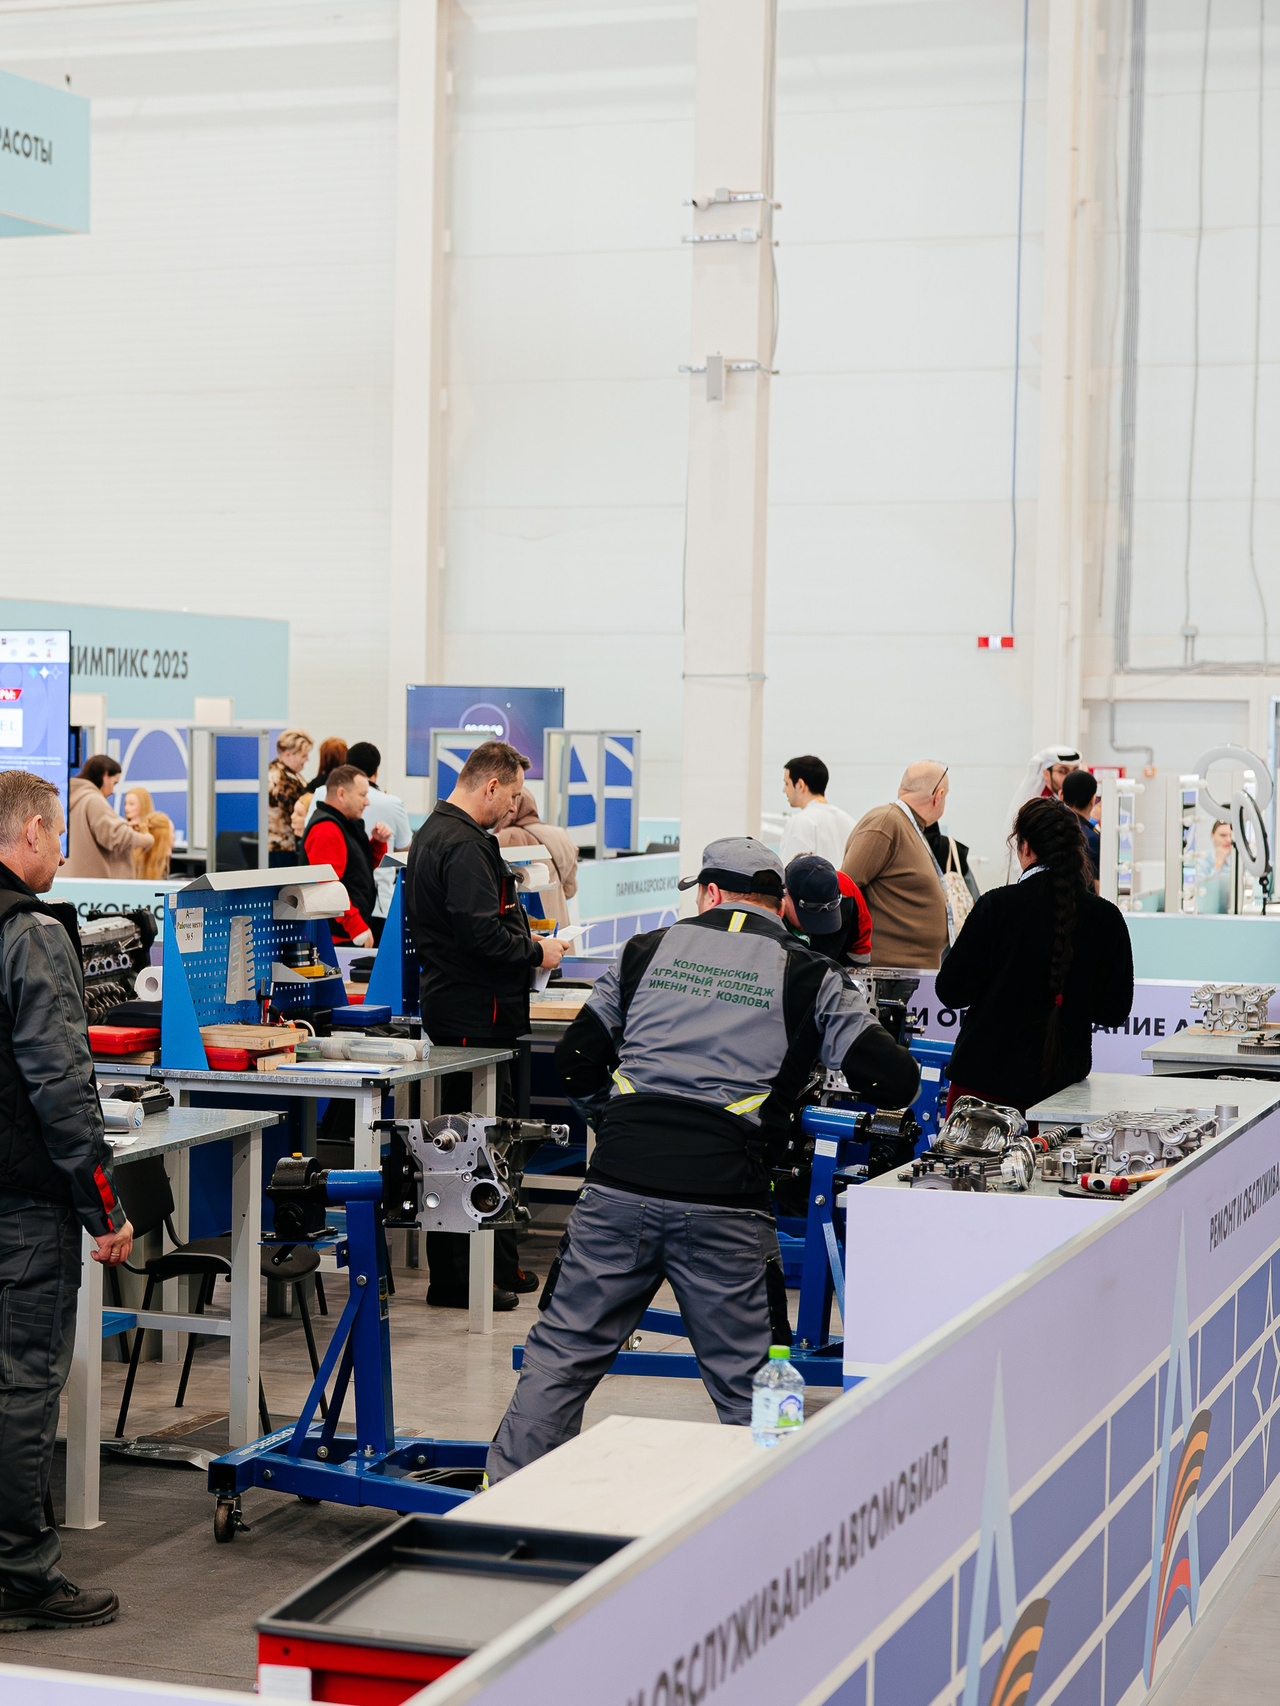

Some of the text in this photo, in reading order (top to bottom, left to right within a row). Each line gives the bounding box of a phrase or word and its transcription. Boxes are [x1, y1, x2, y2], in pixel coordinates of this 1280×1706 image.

[153, 649, 188, 679] 2025
[651, 967, 775, 998] АГРАРНЫЙ КОЛЛЕДЖ
[673, 958, 759, 982] КОЛОМЕНСКИЙ
[648, 979, 770, 1010] ИМЕНИ Н.Т. КОЗЛОВА
[1210, 1197, 1237, 1252] РЕМОНТ
[1237, 1193, 1243, 1228] И
[835, 1435, 949, 1581] АВТОМОБИЛЯ
